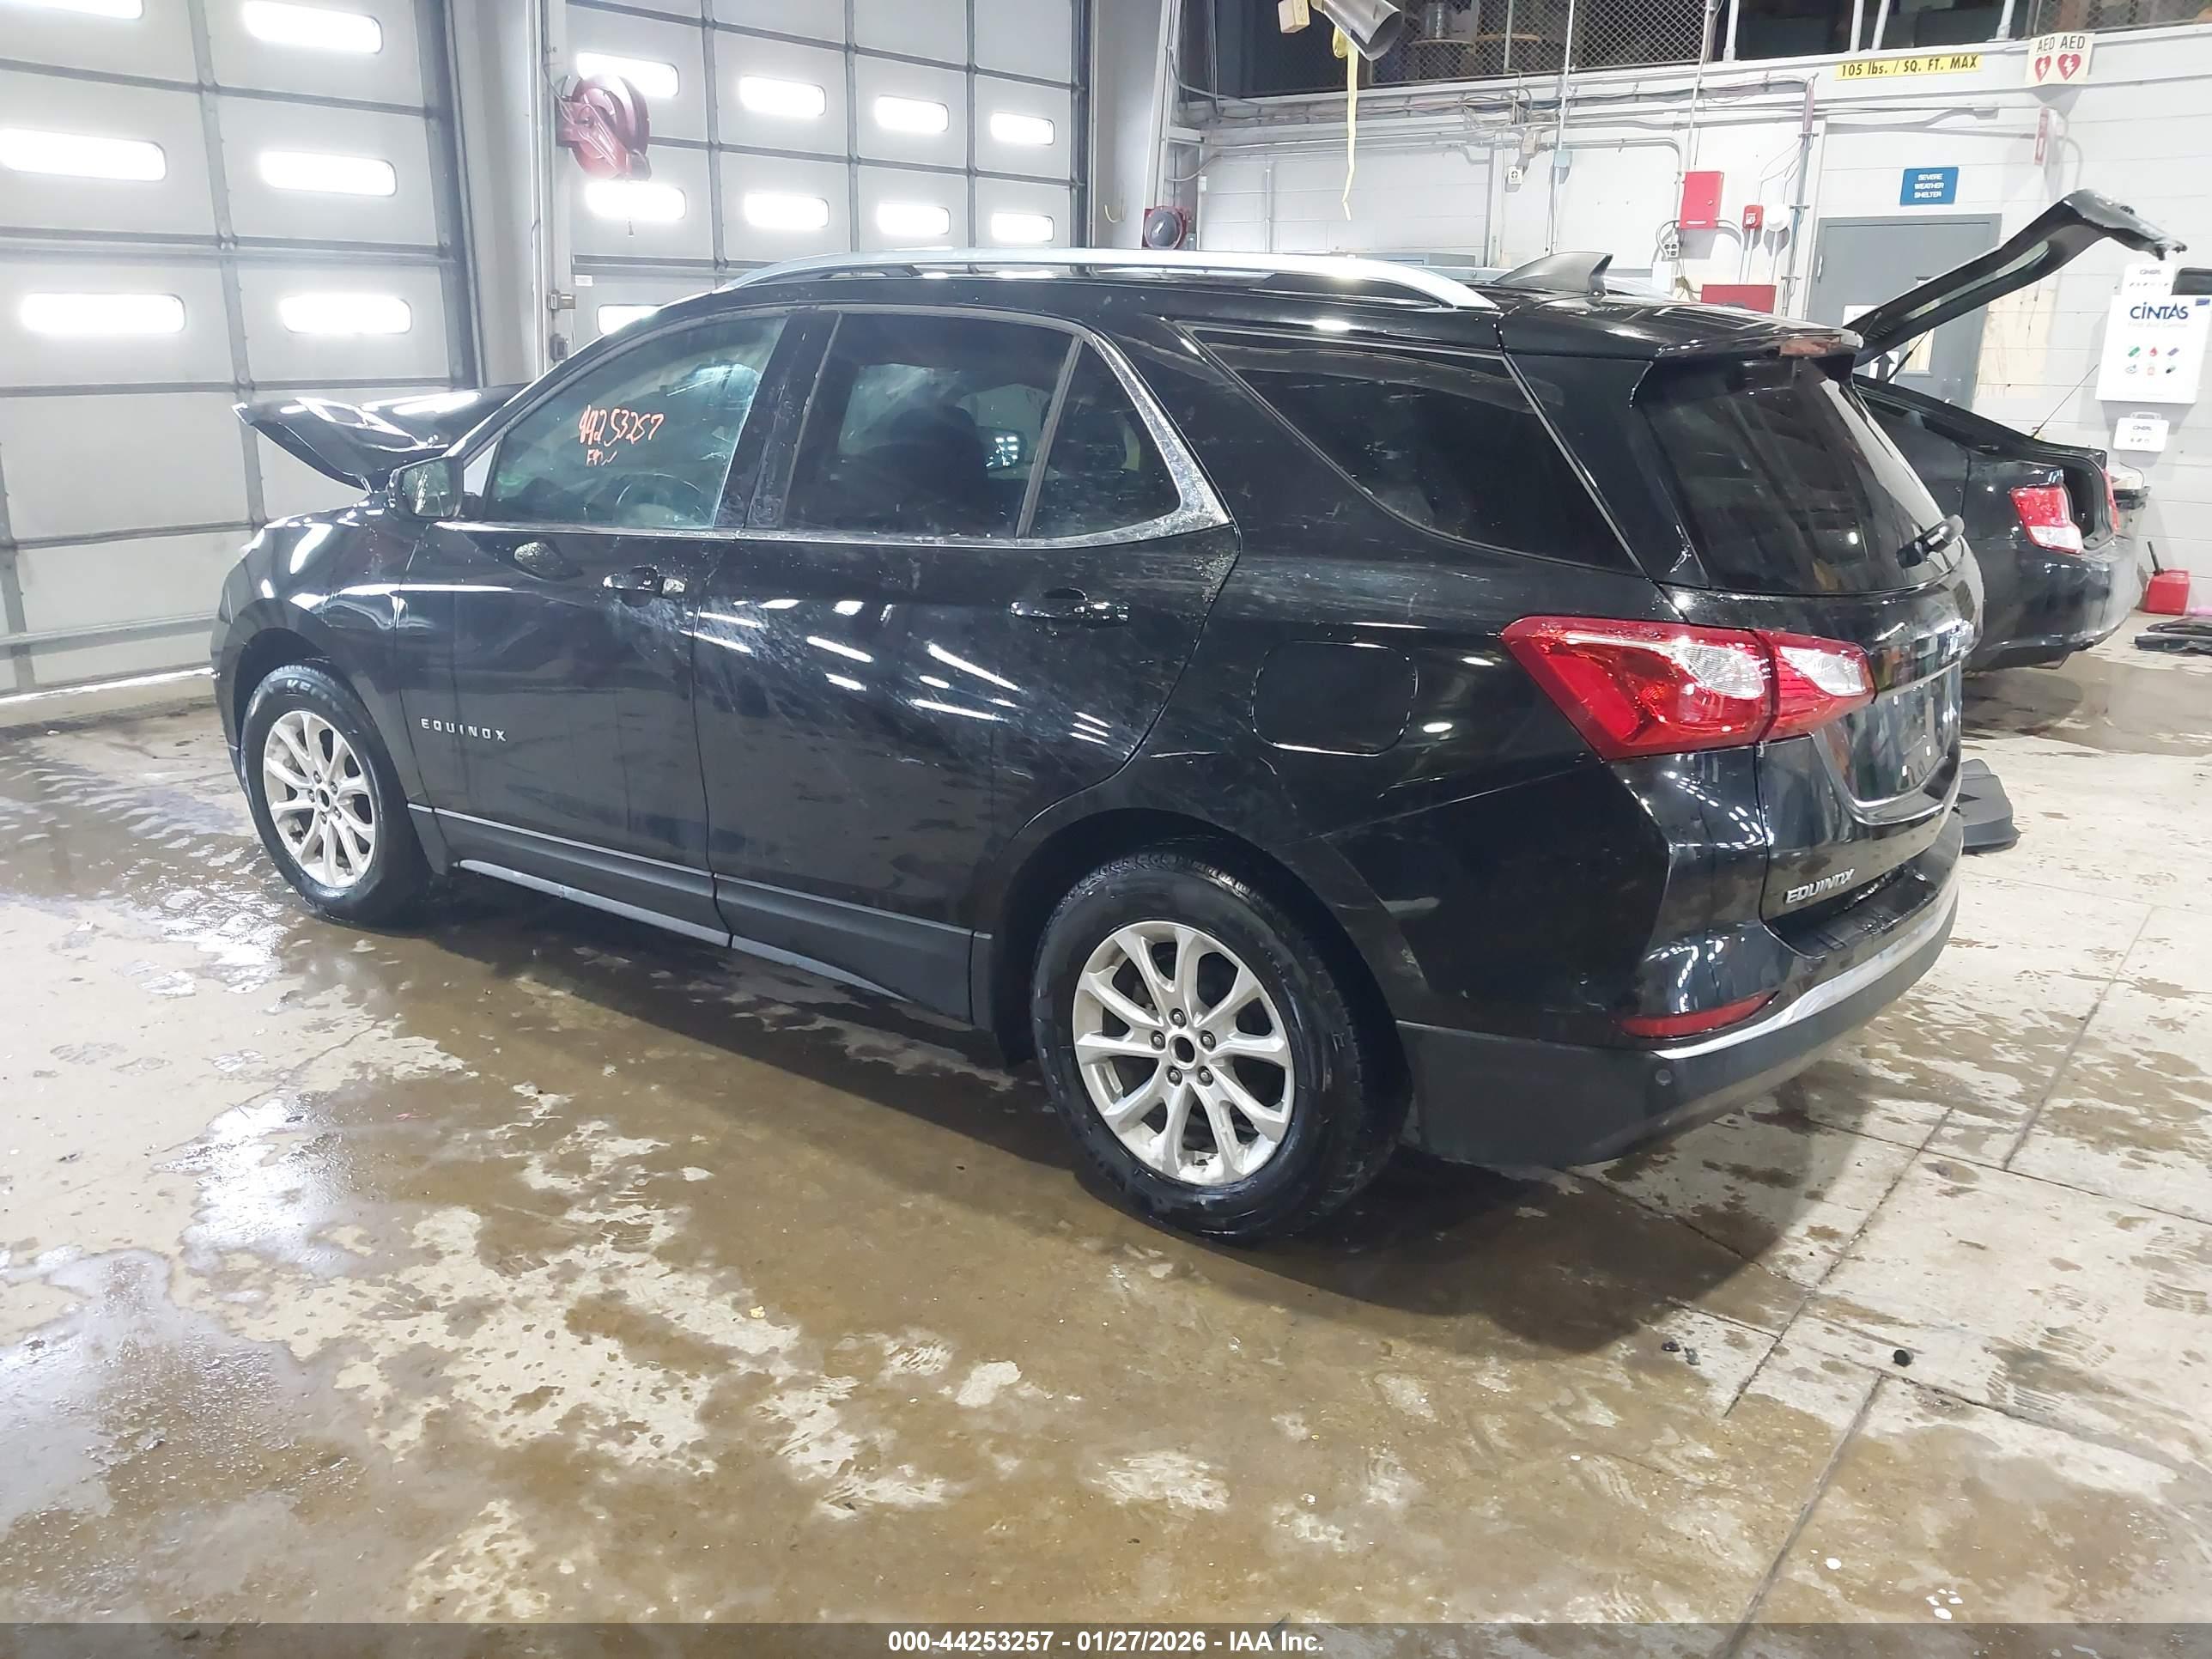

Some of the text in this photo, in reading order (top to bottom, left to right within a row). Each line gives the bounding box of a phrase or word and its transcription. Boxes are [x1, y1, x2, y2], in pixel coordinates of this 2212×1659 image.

[2036, 37, 2055, 52] AED
[2060, 35, 2085, 49] AED
[1842, 55, 1978, 76] 105 lbs. / SQ. FT. MAX
[2130, 301, 2189, 319] CINTAS
[421, 718, 507, 742] EQUINOX
[1785, 868, 1855, 903] EQUINOX
